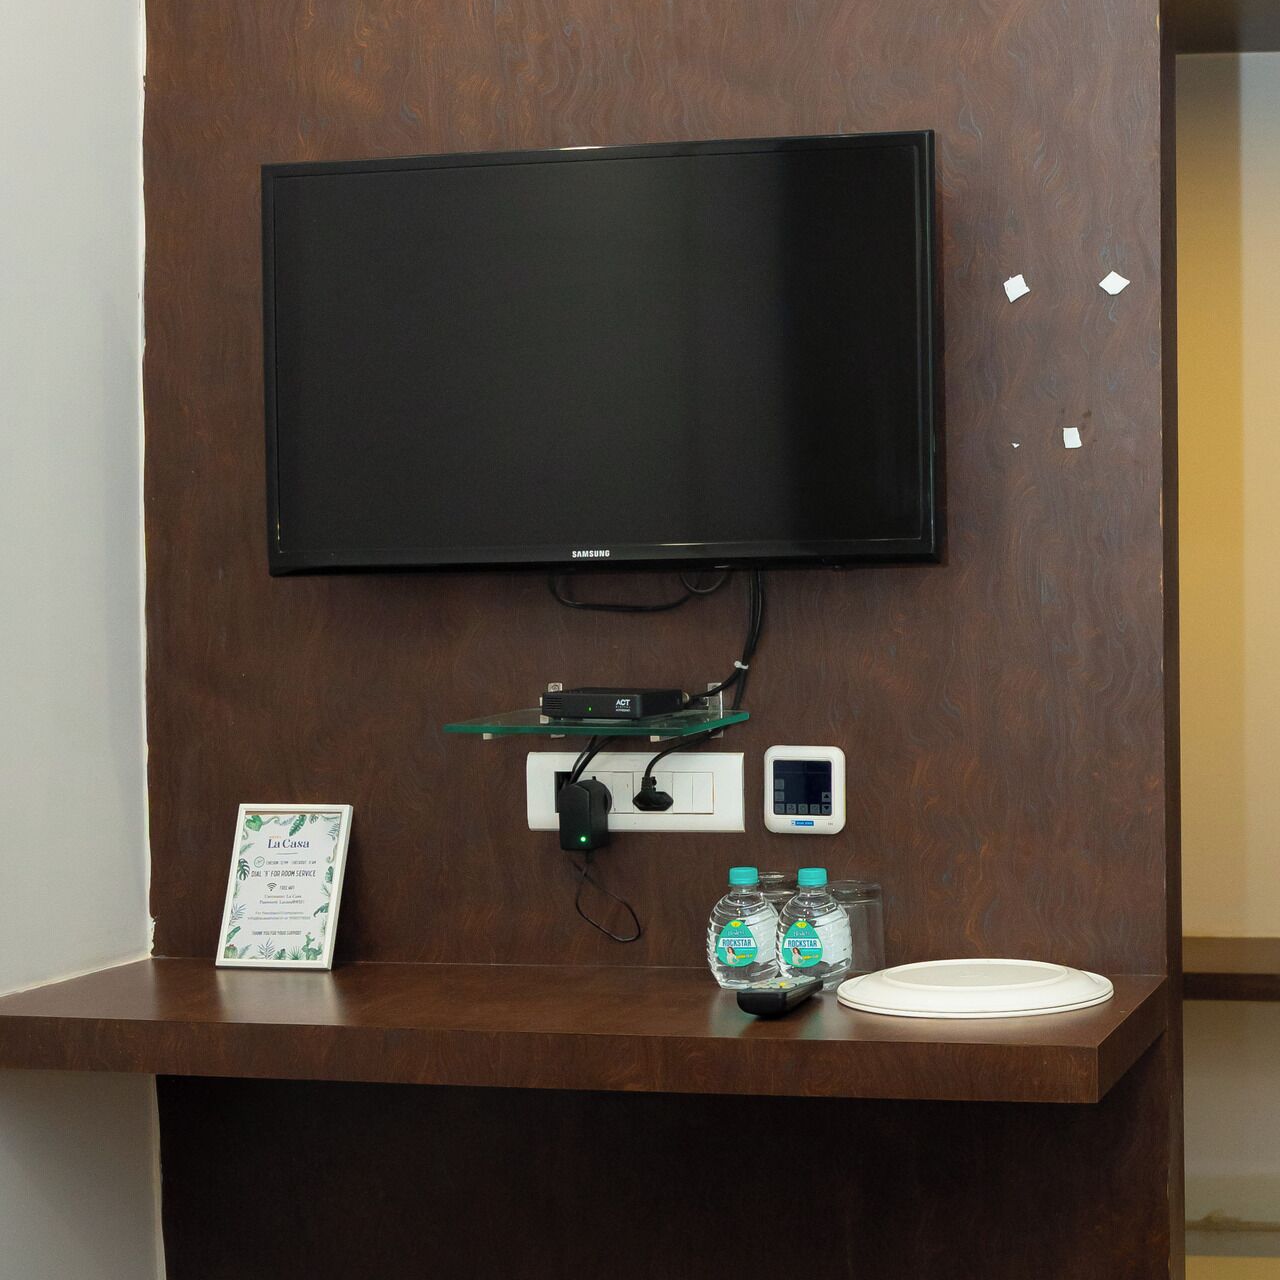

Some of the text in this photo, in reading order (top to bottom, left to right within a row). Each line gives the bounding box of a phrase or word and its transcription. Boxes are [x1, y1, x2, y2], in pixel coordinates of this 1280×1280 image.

[572, 550, 610, 558] SAMSUNG
[268, 839, 310, 848] La Casa
[722, 938, 752, 947] ROCKSTAR
[787, 939, 818, 947] ROCKSTAR
